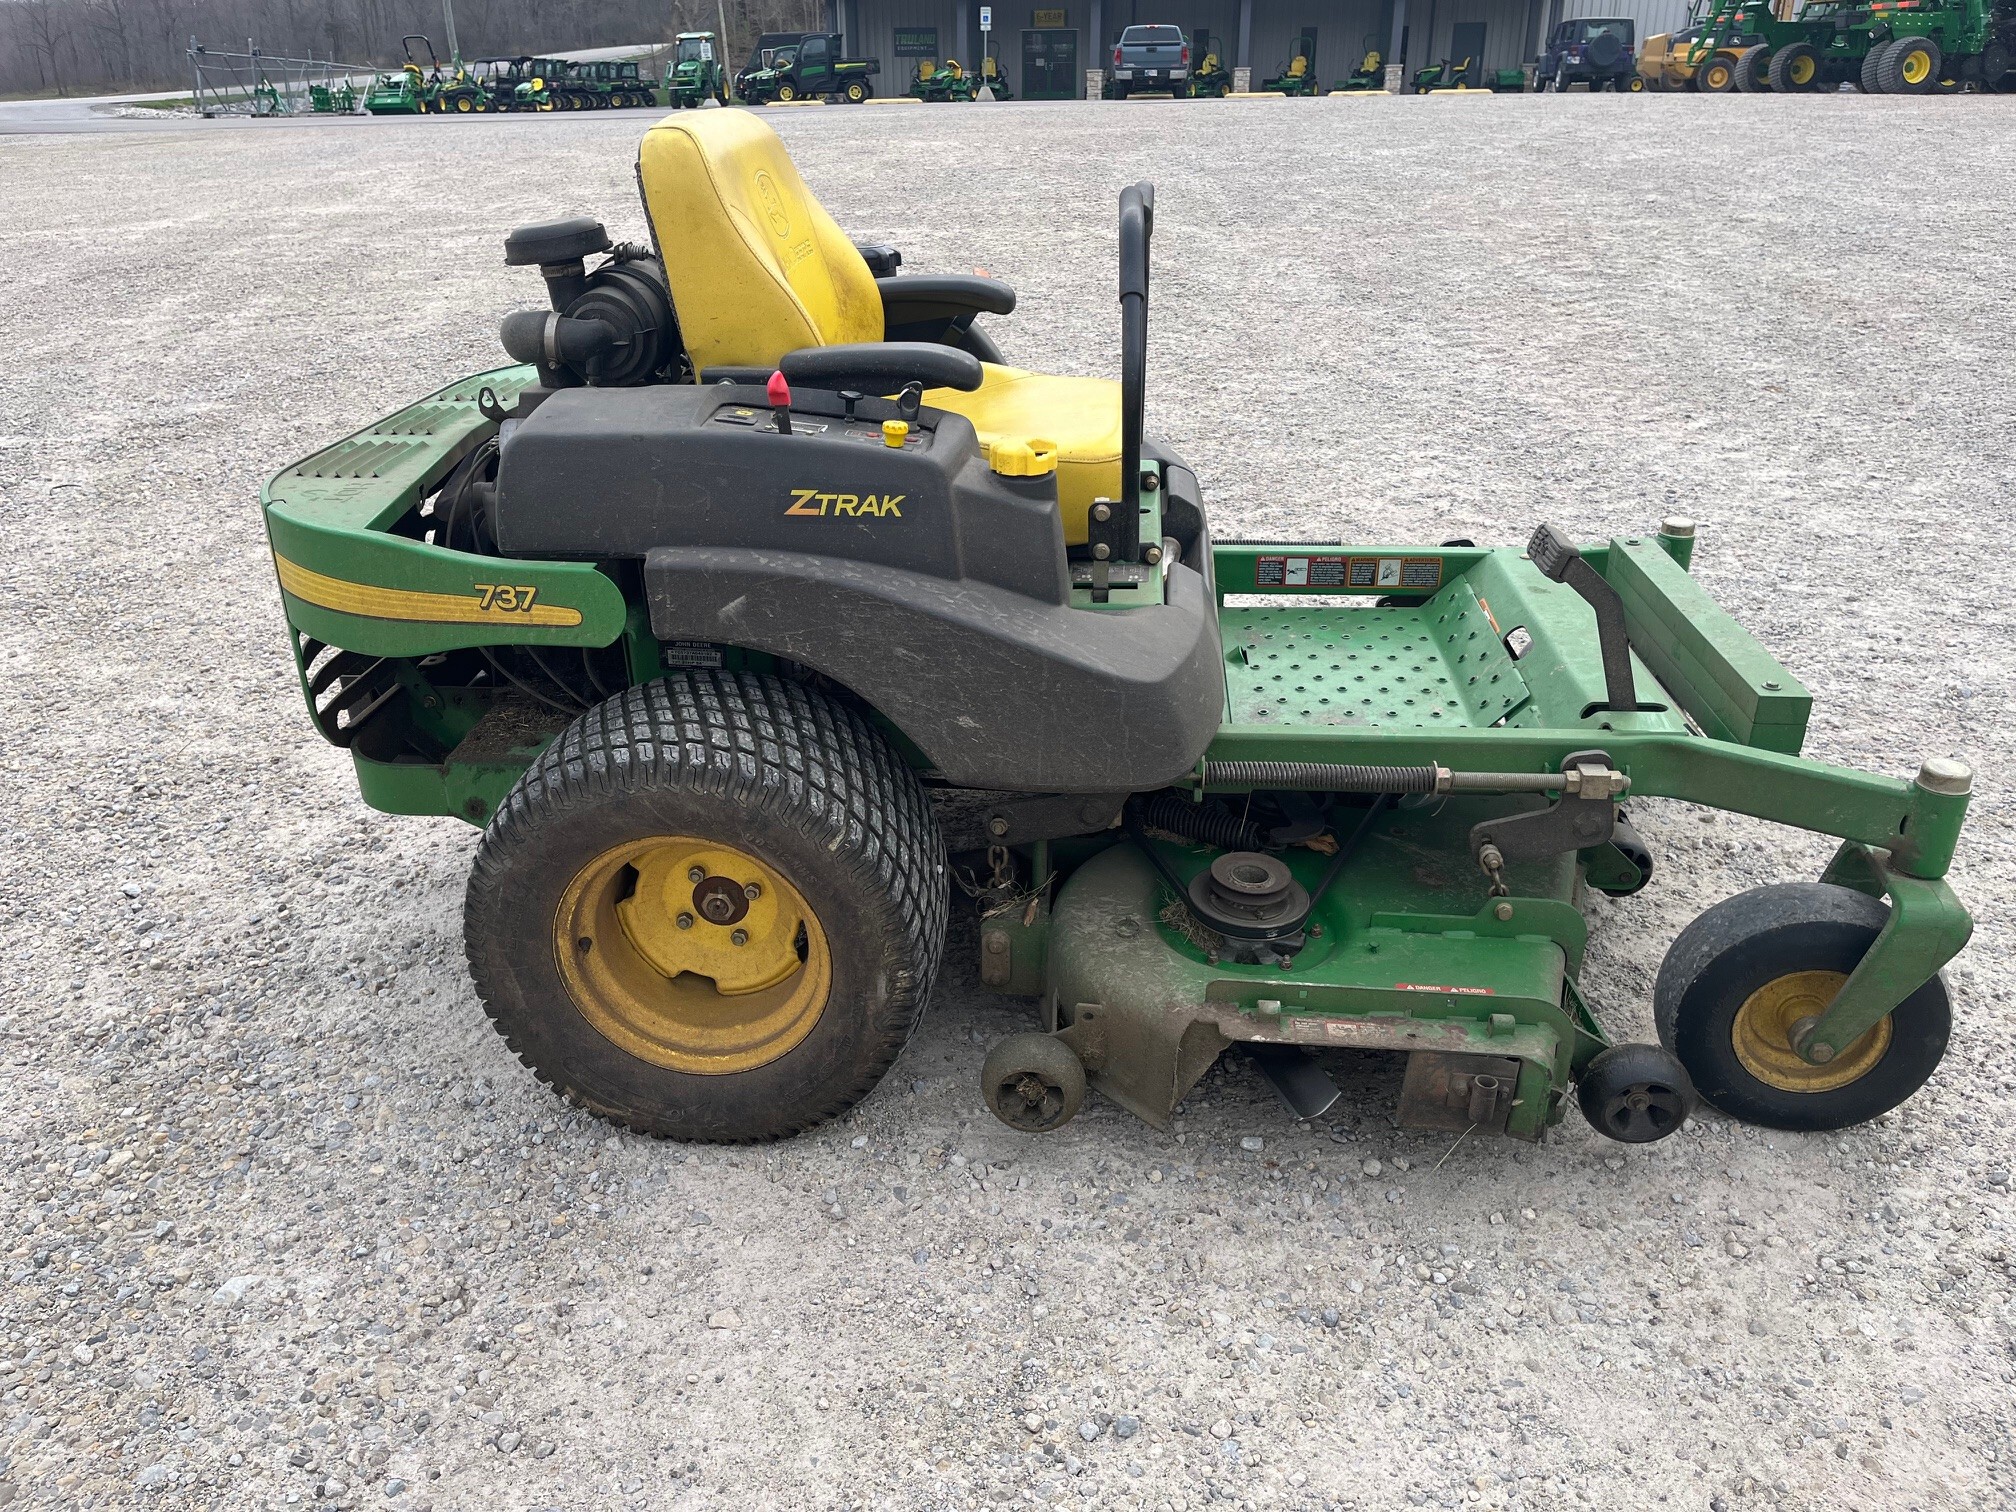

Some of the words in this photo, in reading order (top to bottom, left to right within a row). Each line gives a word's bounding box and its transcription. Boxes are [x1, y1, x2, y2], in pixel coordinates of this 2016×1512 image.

[895, 34, 935, 45] TRULAND
[784, 489, 906, 517] ZTRAK
[474, 584, 539, 612] 737
